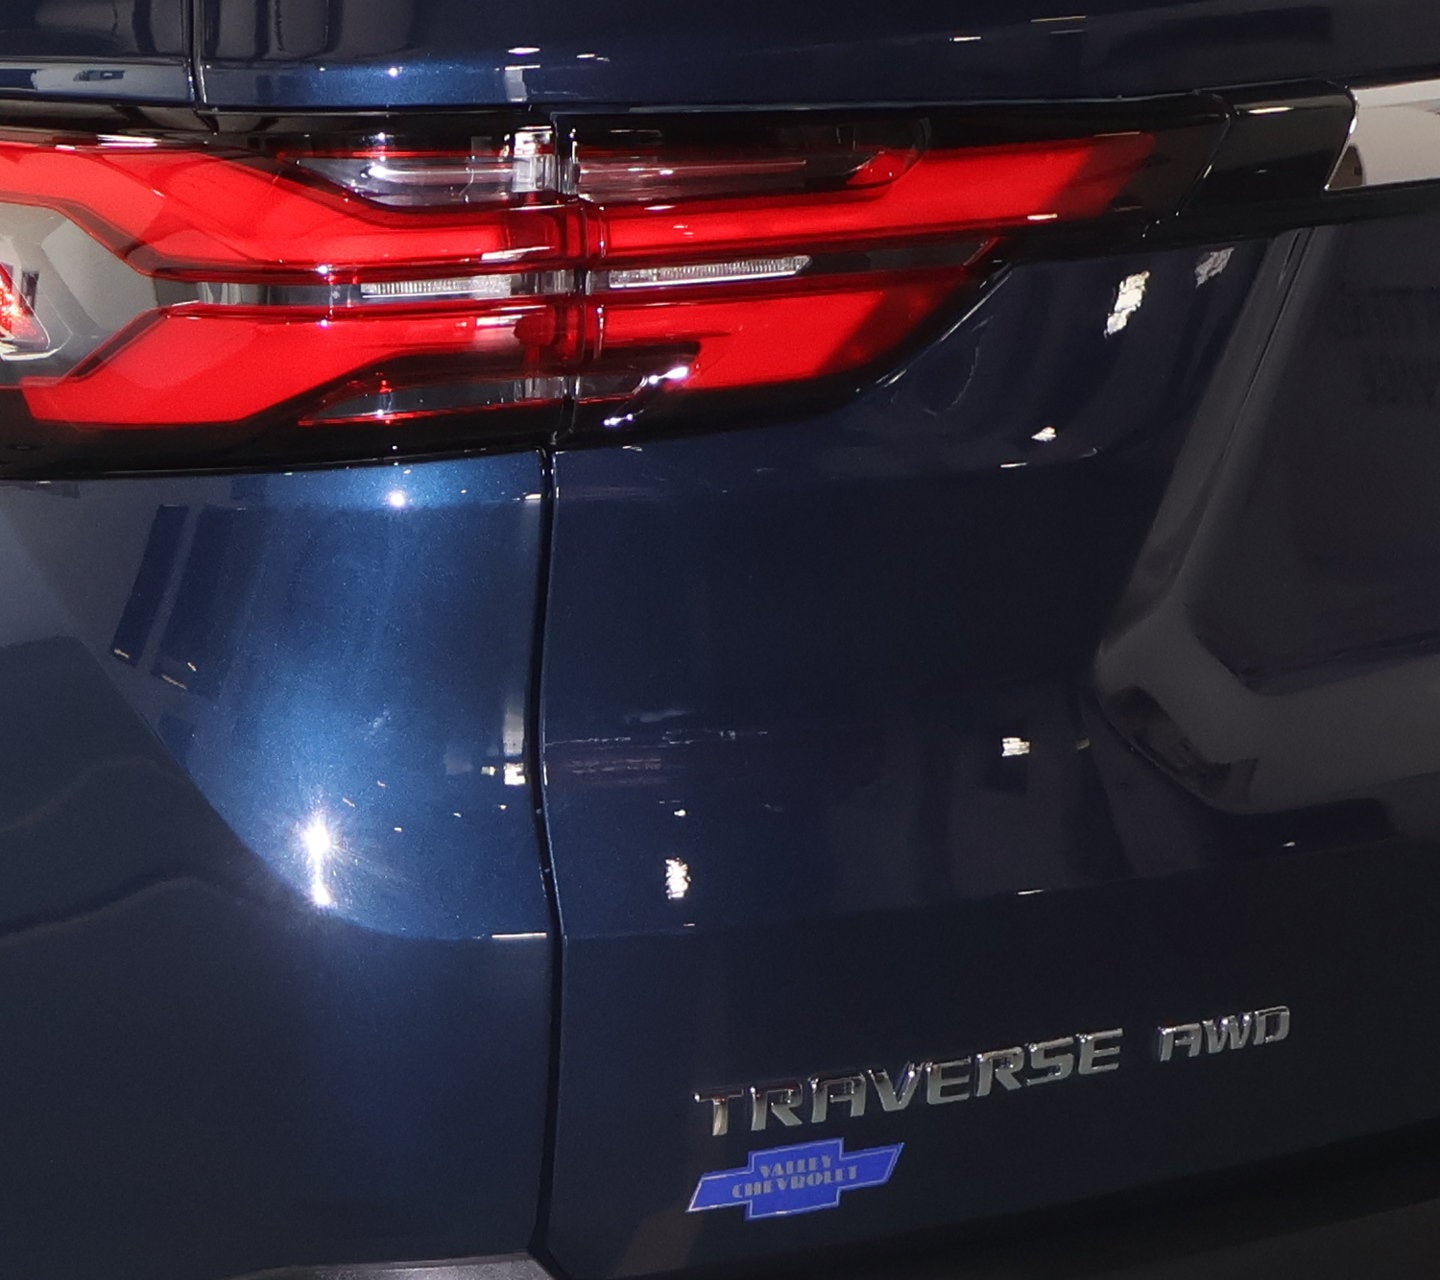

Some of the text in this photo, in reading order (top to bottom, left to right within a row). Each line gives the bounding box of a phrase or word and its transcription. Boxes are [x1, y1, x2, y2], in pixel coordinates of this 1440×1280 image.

[693, 1006, 1292, 1136] TRAVERSE AWD
[731, 1164, 858, 1199] CHEVROLET
[760, 1154, 833, 1179] VALLEY
